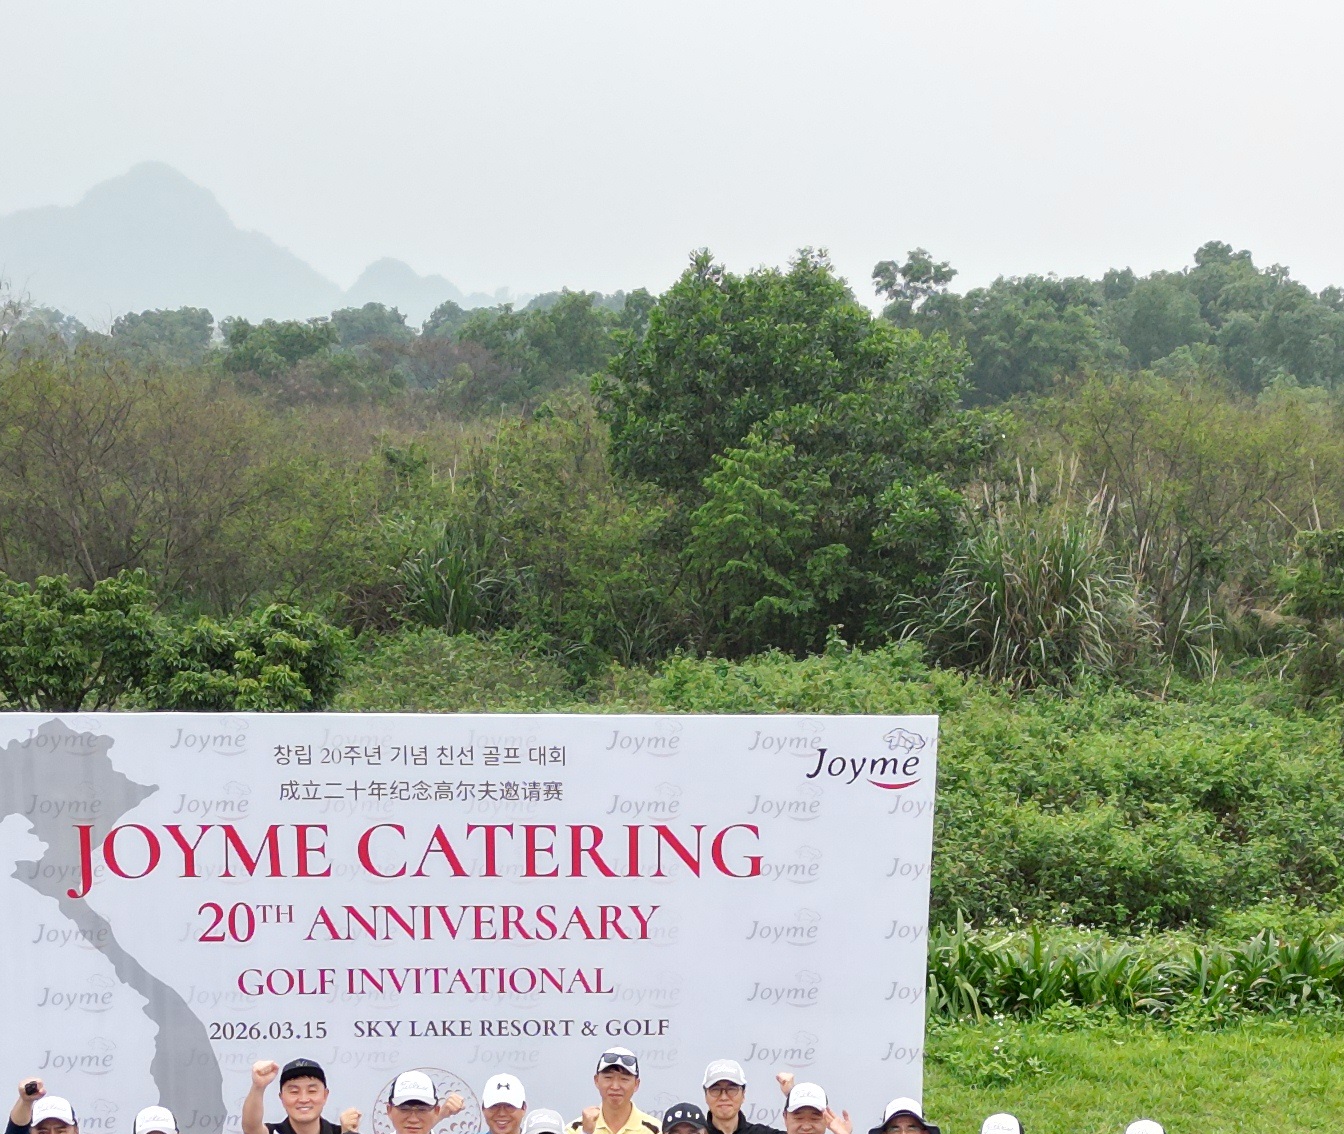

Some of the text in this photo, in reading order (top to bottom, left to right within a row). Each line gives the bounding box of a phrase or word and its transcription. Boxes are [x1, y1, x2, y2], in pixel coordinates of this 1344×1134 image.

[170, 728, 247, 753] Joyme
[606, 730, 680, 754] Joyme
[748, 730, 822, 754] Joyme
[272, 744, 567, 767] 창립 20주년 기념 친선 골프 대회
[806, 747, 921, 785] Joyme
[278, 779, 565, 802] 成立二十年纪念高尔夫邀请赛
[173, 793, 249, 817] Joyme
[606, 794, 680, 818] Joyme
[748, 794, 821, 818] Joyme
[66, 822, 765, 899] JOYME CATERING
[197, 901, 295, 943] 20TH
[302, 903, 661, 941] ANNIVERSARY
[746, 920, 818, 943] Joyme
[237, 966, 614, 996] GOLF INVITATIONAL
[37, 987, 113, 1010] Joyme
[747, 982, 819, 1006] Joyme
[209, 1020, 328, 1040] 2026.03.15
[353, 1018, 670, 1038] SKY LAKE RESORT & GOLF
[39, 1050, 114, 1073] Joyme
[745, 1043, 816, 1066] Joyme
